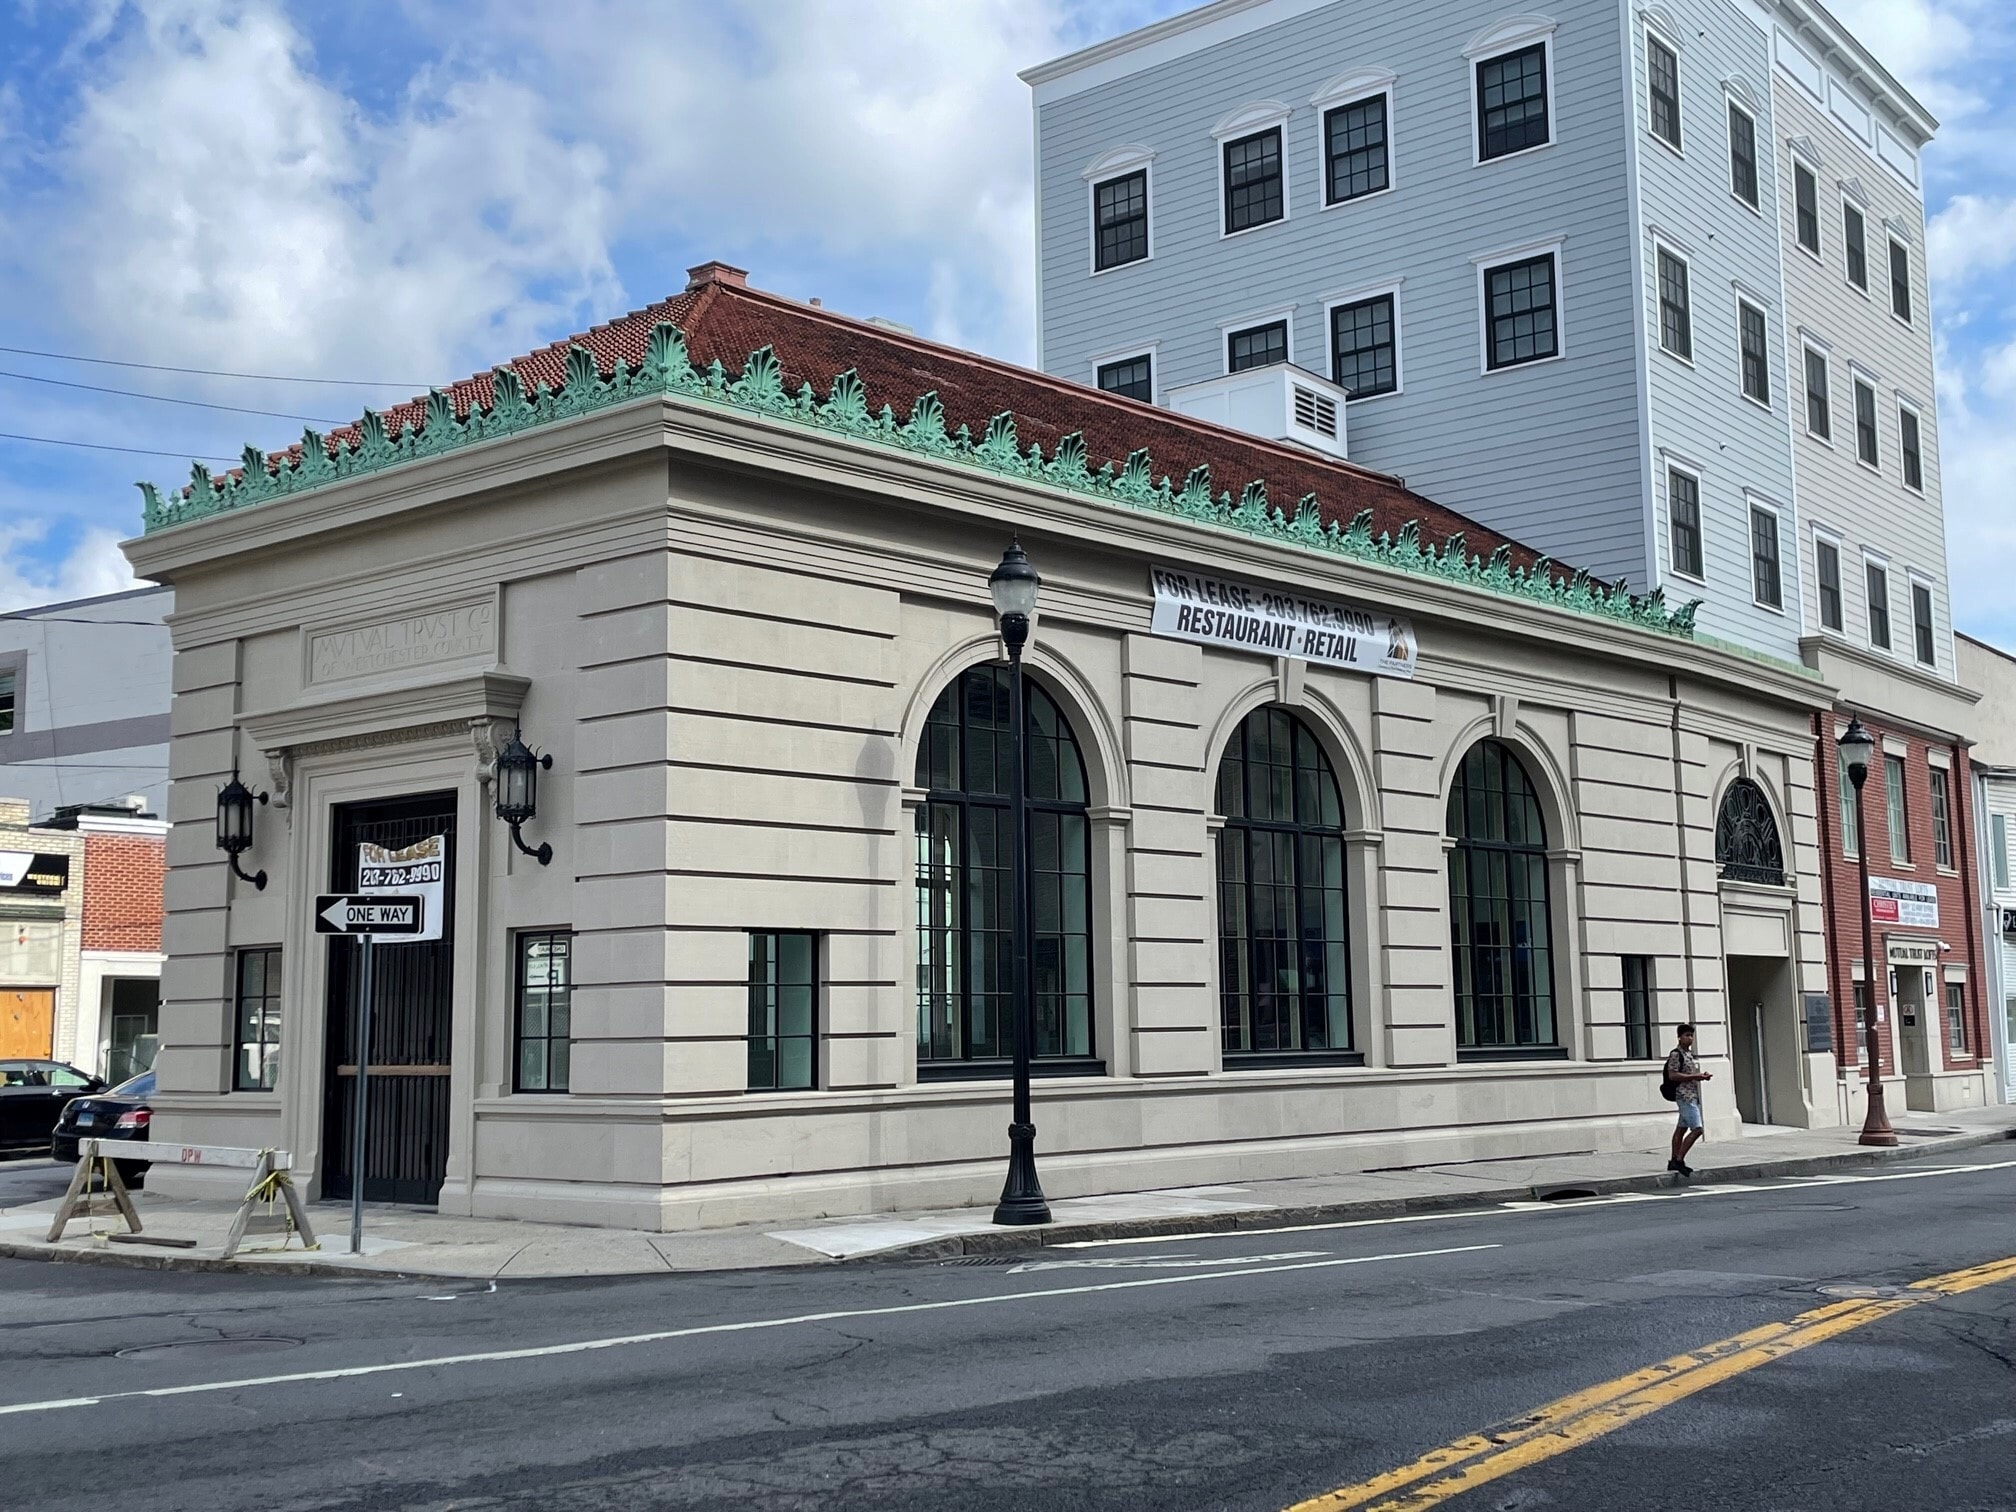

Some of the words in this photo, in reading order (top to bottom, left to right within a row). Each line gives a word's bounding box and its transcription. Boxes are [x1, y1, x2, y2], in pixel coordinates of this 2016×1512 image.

[1153, 569, 1191, 600] FOR
[1196, 578, 1253, 613] LEASE
[1177, 604, 1296, 650] RESTAURANT
[1303, 630, 1358, 662] RETAIL
[322, 661, 338, 677] OF
[344, 644, 430, 673] WESTCHESTER
[363, 844, 386, 863] FOR
[389, 837, 440, 862] LEASE
[346, 907, 375, 922] ONE
[380, 907, 409, 922] WAY
[1909, 948, 1922, 960] TRUST
[181, 1148, 202, 1165] DPW
